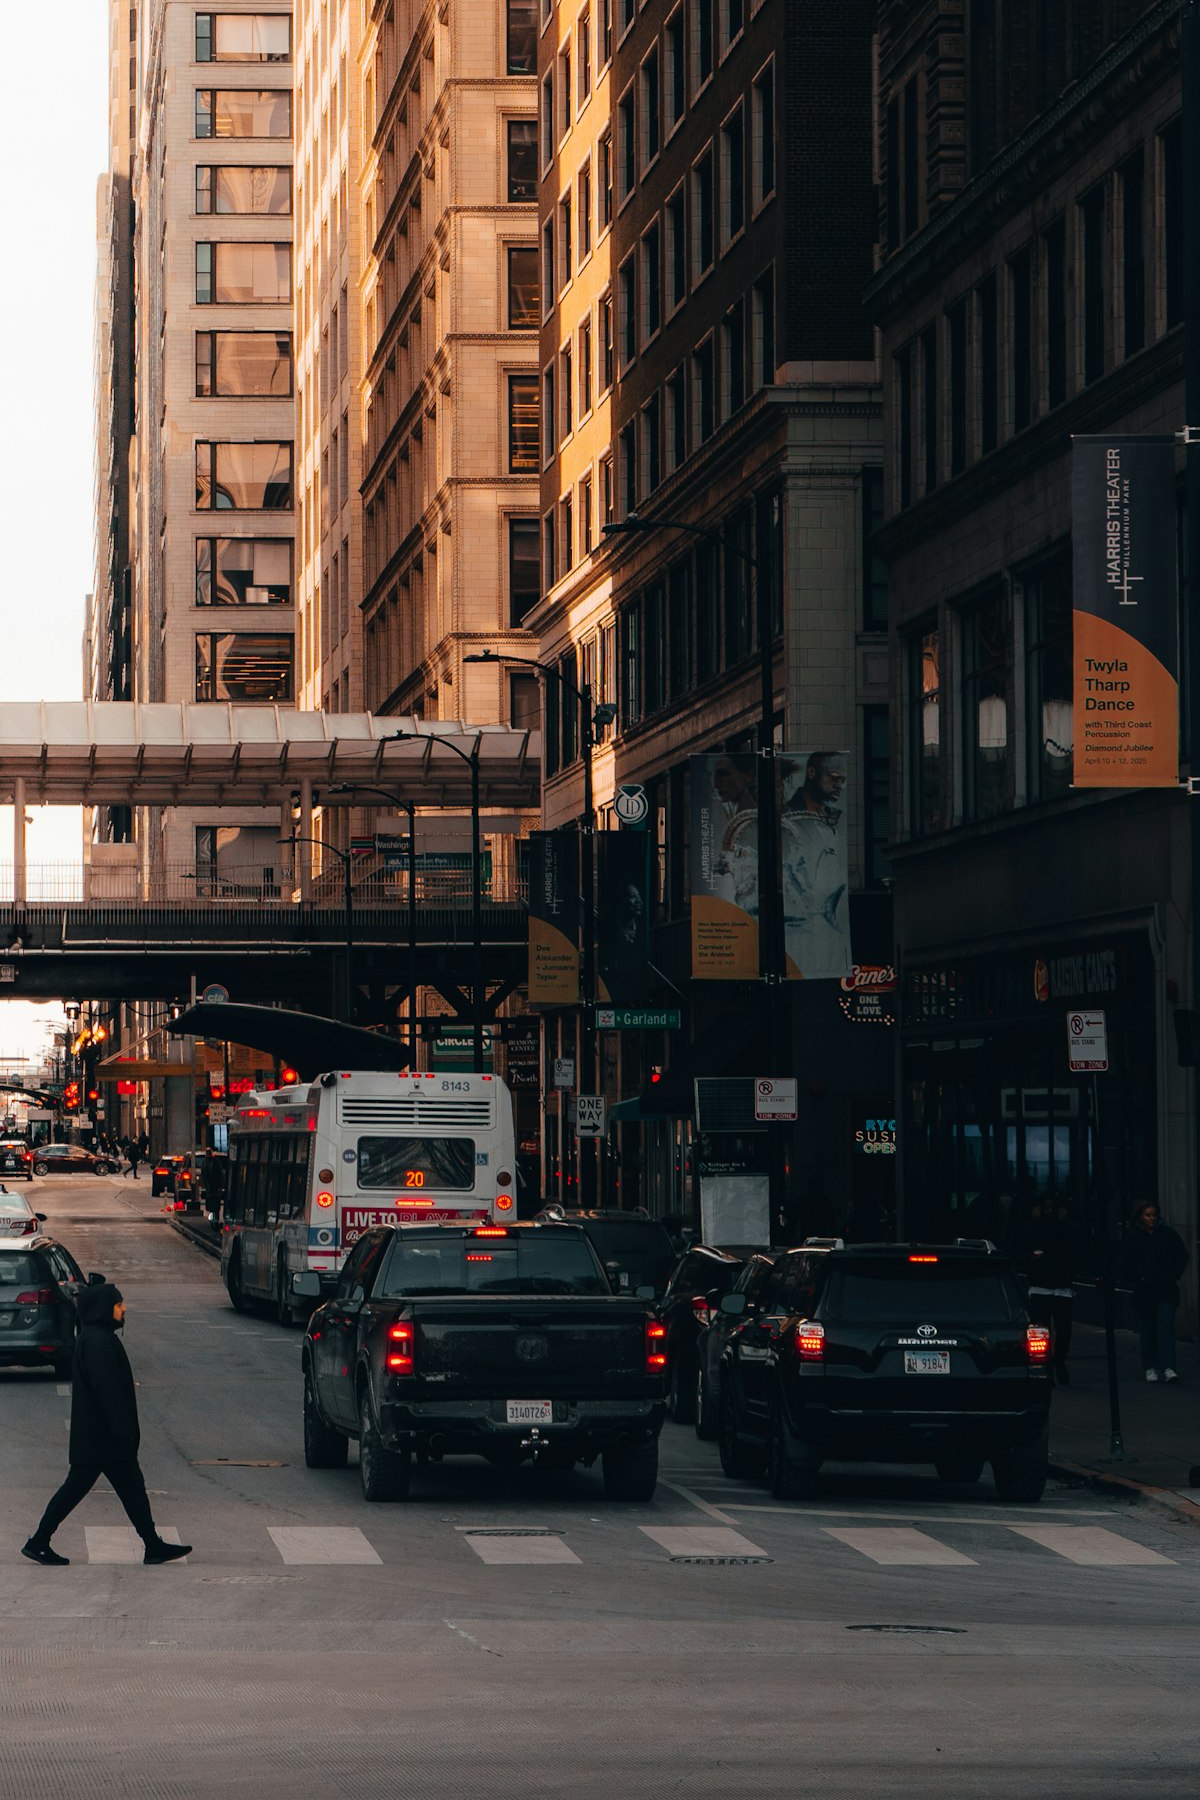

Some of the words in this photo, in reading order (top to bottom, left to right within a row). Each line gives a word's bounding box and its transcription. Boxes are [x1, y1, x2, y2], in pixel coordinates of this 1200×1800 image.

[1106, 448, 1121, 520] THEATER
[1106, 520, 1121, 583] HARRIS
[1085, 658, 1129, 675] Twyla
[1085, 678, 1131, 694] Tharp
[1085, 698, 1136, 711] Dance
[1084, 730, 1131, 738] Percussion
[1085, 744, 1123, 752] Diamond
[1124, 744, 1154, 752] Jubilee
[1084, 757, 1101, 766] April
[700, 807, 710, 844] THEATER
[374, 840, 411, 850] Washingt
[544, 836, 554, 871] THEATER
[701, 843, 711, 879] HARRIS
[544, 871, 553, 904] HARRIS
[535, 954, 573, 962] Alexander
[841, 965, 895, 992] Cane's
[207, 993, 225, 1002] cta
[859, 995, 880, 1005] ONE
[856, 1006, 882, 1016] LOVE
[623, 1012, 667, 1025] Garland
[1071, 1061, 1087, 1069] TOW
[1087, 1060, 1105, 1068] ZONE
[441, 1081, 471, 1092] 8143
[579, 1099, 602, 1110] ONE
[578, 1110, 602, 1121] WAY
[405, 1171, 425, 1188] 20
[346, 1211, 378, 1228] LIVE
[378, 1211, 398, 1225] TO
[897, 1337, 958, 1346] 4RUNNER
